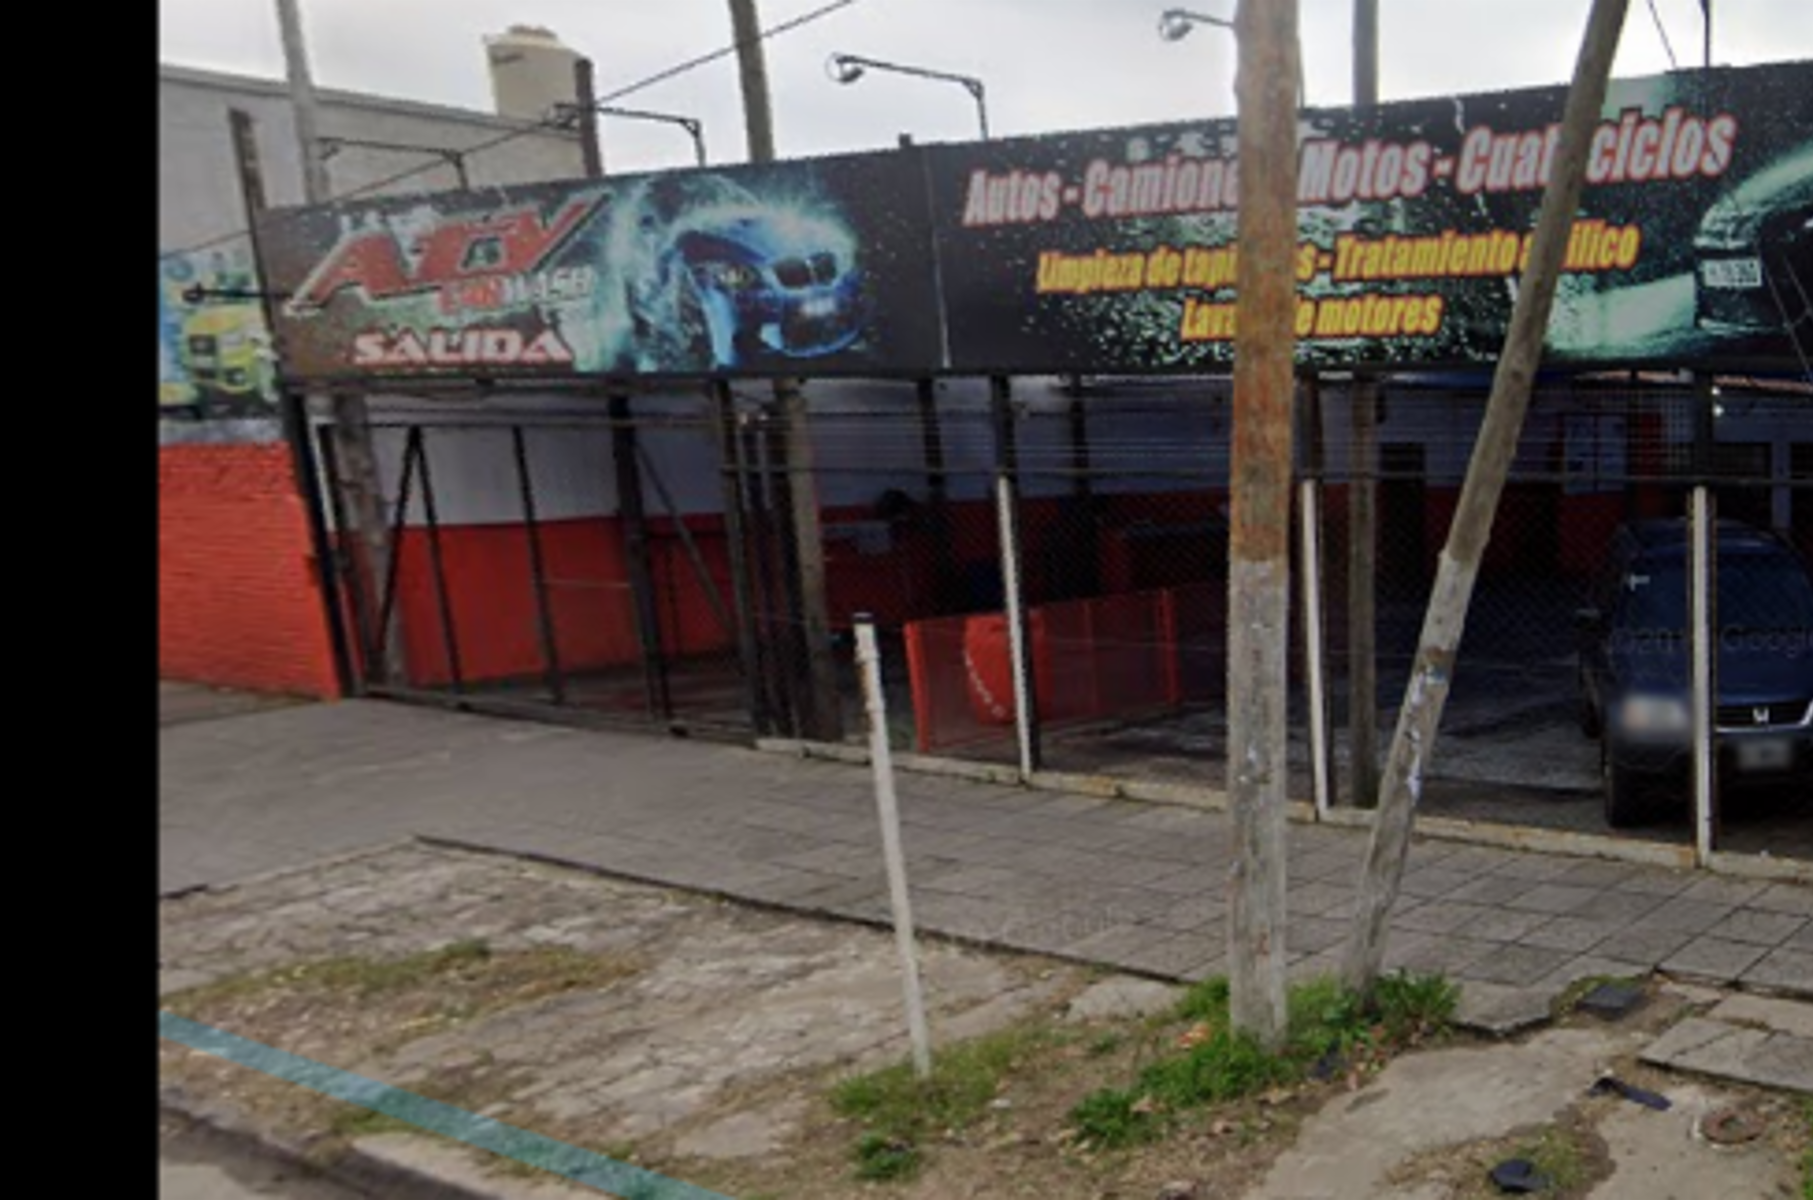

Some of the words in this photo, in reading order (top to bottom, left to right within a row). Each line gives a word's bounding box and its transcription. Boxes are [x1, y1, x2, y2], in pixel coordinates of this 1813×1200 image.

[963, 170, 1061, 226] Autos
[1083, 154, 1242, 217] Camione
[1296, 139, 1431, 202] Motos
[1456, 107, 1737, 196] Cuatciclos
[1037, 248, 1146, 294] Limpieza
[1147, 245, 1182, 287] de
[1183, 241, 1316, 288] tapis
[1333, 228, 1520, 280] Tratamiento
[1520, 219, 1640, 273] ailico
[1315, 291, 1443, 337] motores
[353, 328, 573, 365] SALIDA
